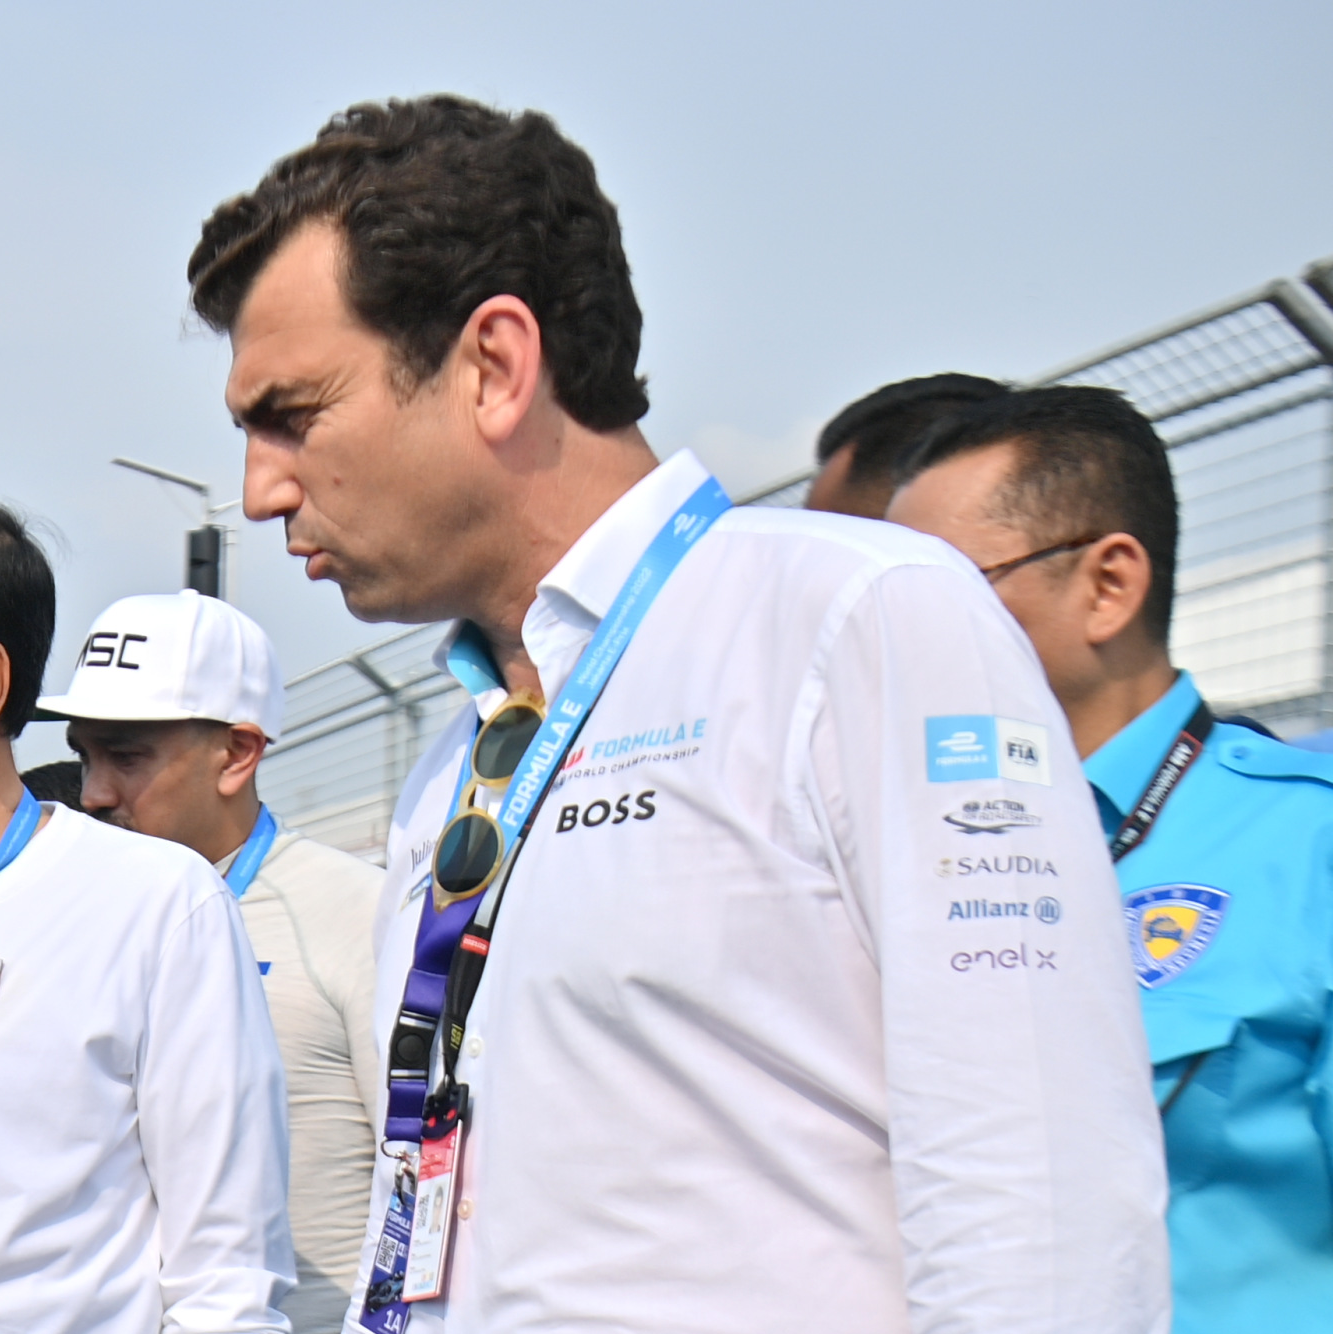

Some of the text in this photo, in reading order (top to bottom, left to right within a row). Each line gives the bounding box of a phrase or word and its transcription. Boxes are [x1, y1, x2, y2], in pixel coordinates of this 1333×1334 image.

[591, 723, 688, 760] FORMULA
[692, 718, 707, 739] E
[502, 721, 572, 827] FORMULA
[560, 698, 583, 719] E
[610, 746, 700, 774] CHAMPIONSHIP
[555, 789, 657, 833] BOSS
[956, 855, 1059, 877] SAUDIA
[947, 898, 1030, 921] Allianz
[950, 941, 1029, 972] enel
